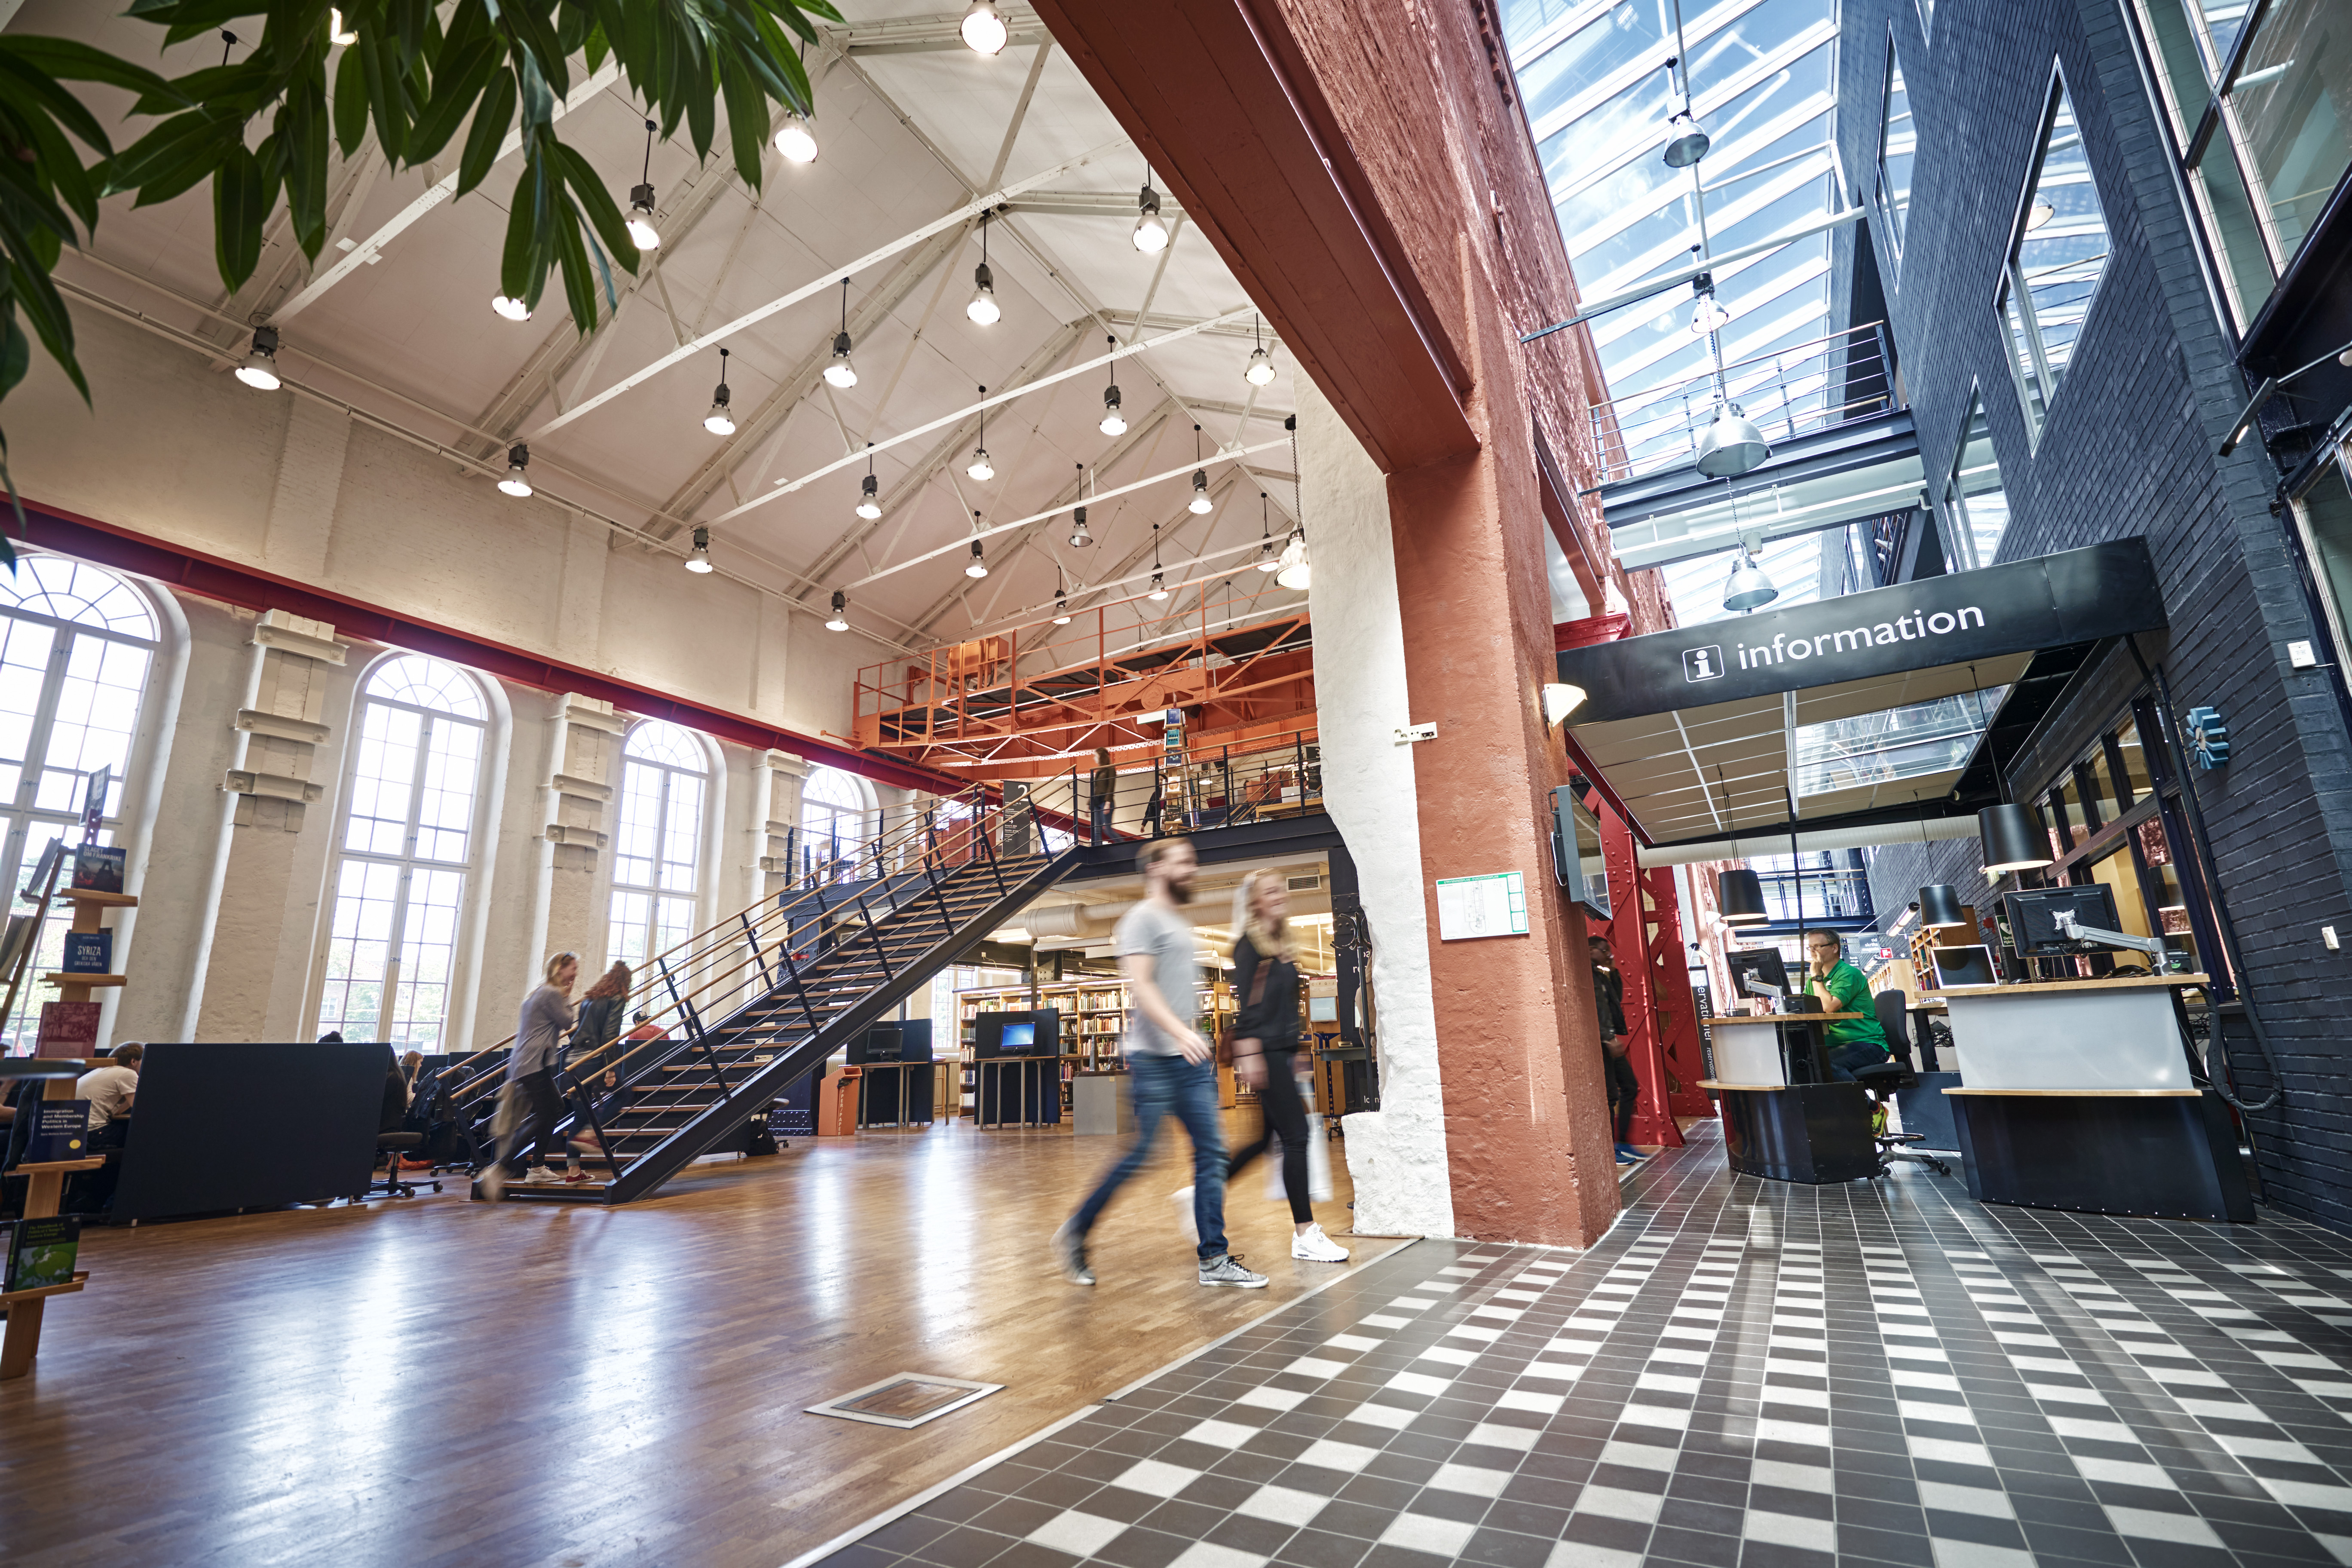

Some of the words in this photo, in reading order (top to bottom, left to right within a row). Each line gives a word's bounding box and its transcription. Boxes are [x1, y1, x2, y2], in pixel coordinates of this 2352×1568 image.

[1737, 607, 1985, 670] information
[1018, 784, 1029, 801] 2
[93, 853, 122, 862] FRANKRIKE
[78, 945, 101, 956] SYRIZA
[1706, 1047, 1716, 1080] reservations
